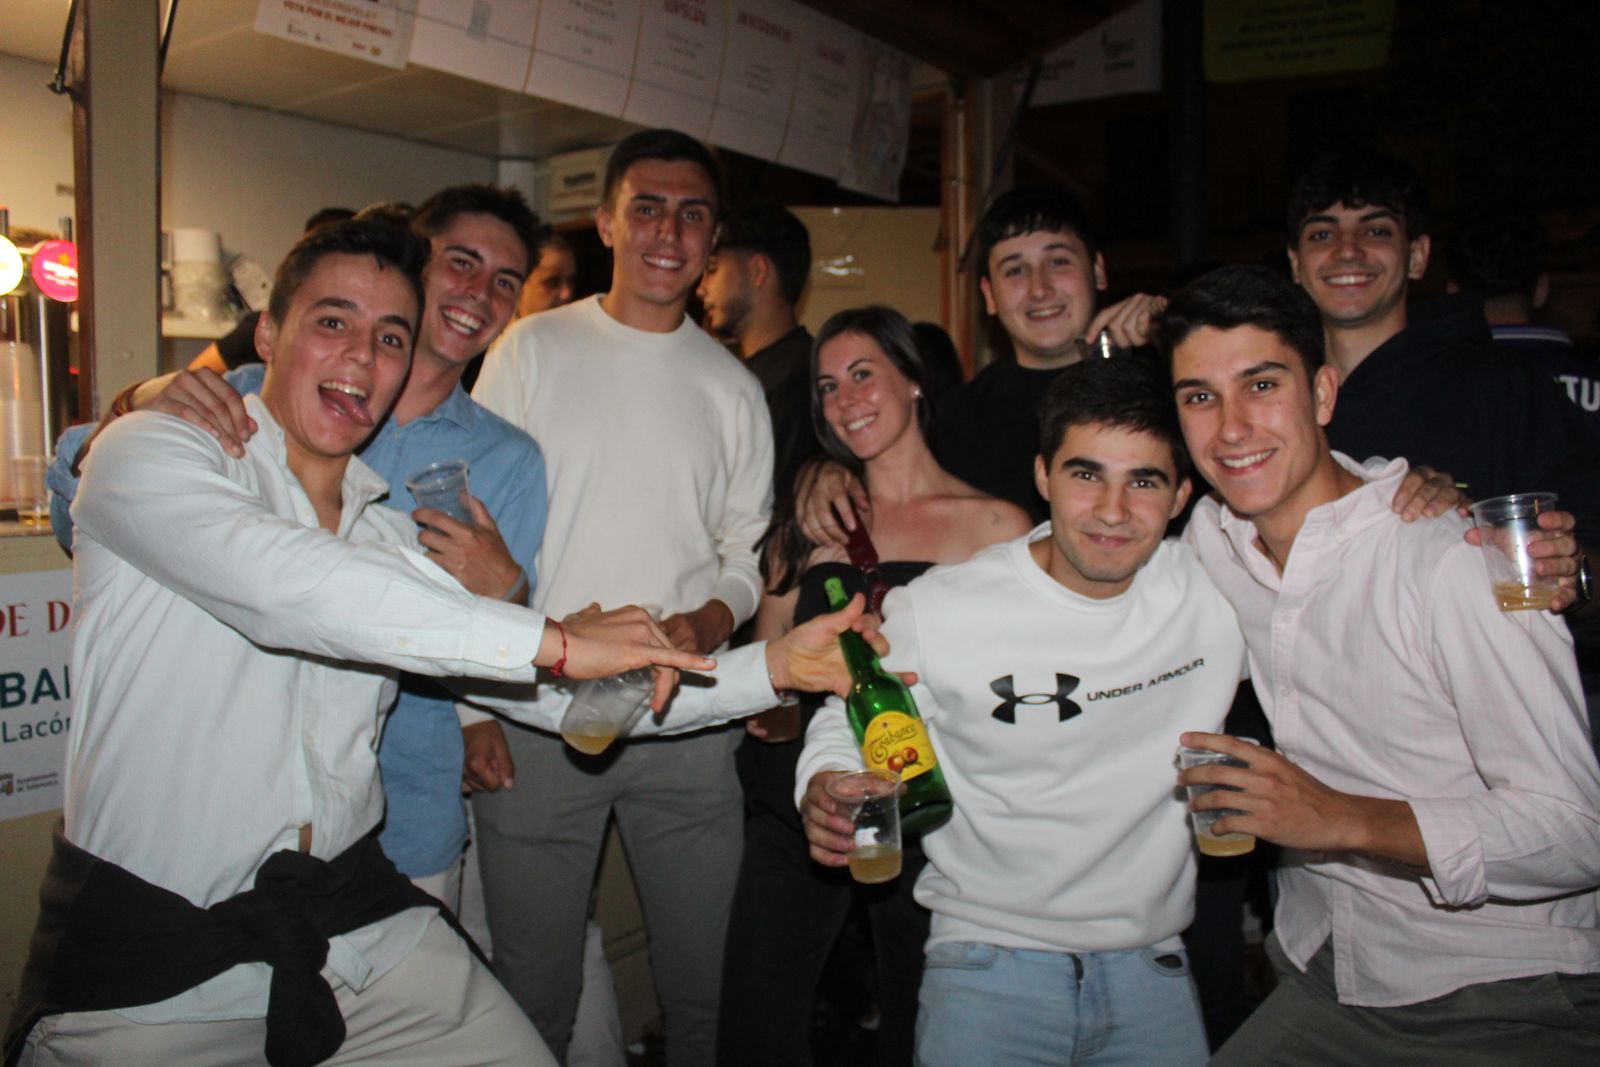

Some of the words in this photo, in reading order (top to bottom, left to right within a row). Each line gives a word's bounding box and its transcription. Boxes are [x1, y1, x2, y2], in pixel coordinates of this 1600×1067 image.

[1553, 374, 1600, 412] TU
[0, 602, 30, 637] E
[1087, 683, 1143, 702] UNDER
[1147, 657, 1205, 688] ARMOUR
